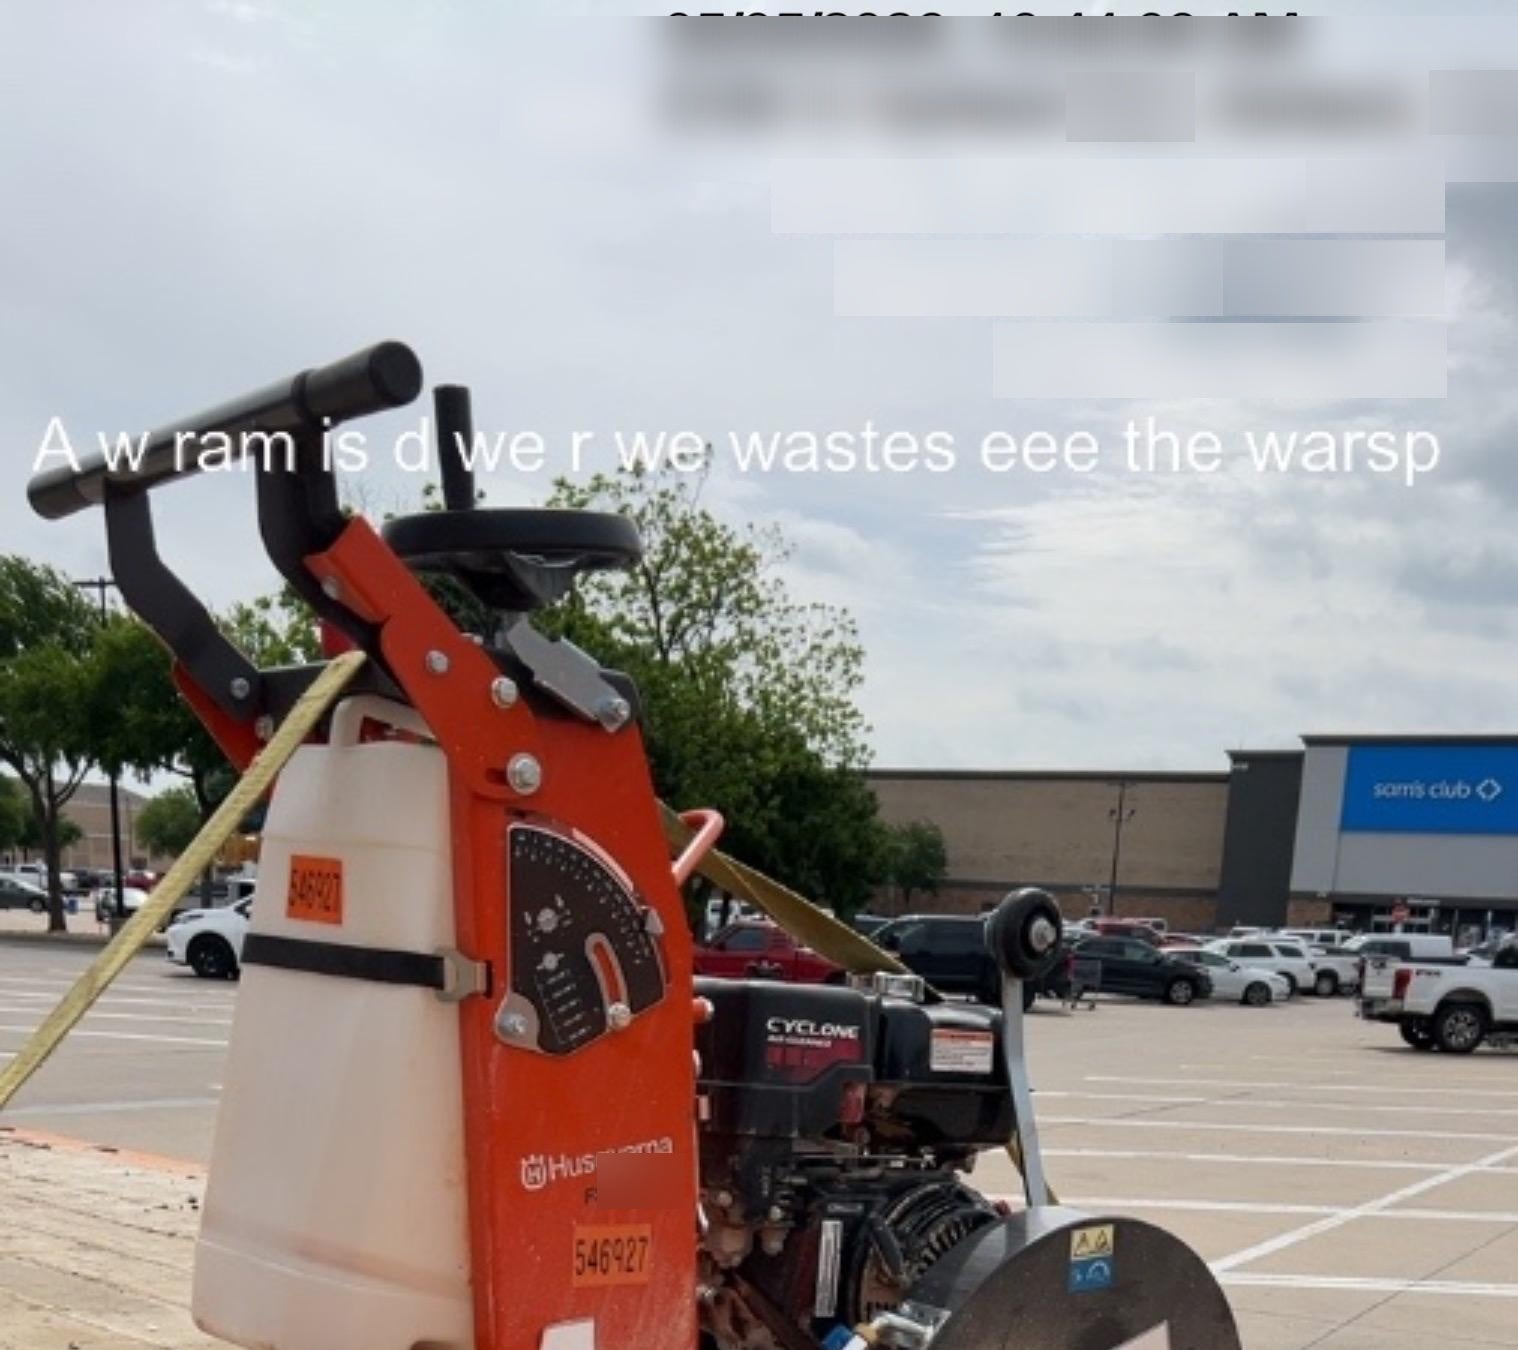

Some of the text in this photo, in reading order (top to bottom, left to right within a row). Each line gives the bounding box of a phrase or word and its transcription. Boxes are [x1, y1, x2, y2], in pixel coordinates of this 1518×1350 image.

[1428, 779, 1471, 799] club
[766, 1016, 860, 1040] CYCLONE
[575, 1236, 649, 1275] 546927
